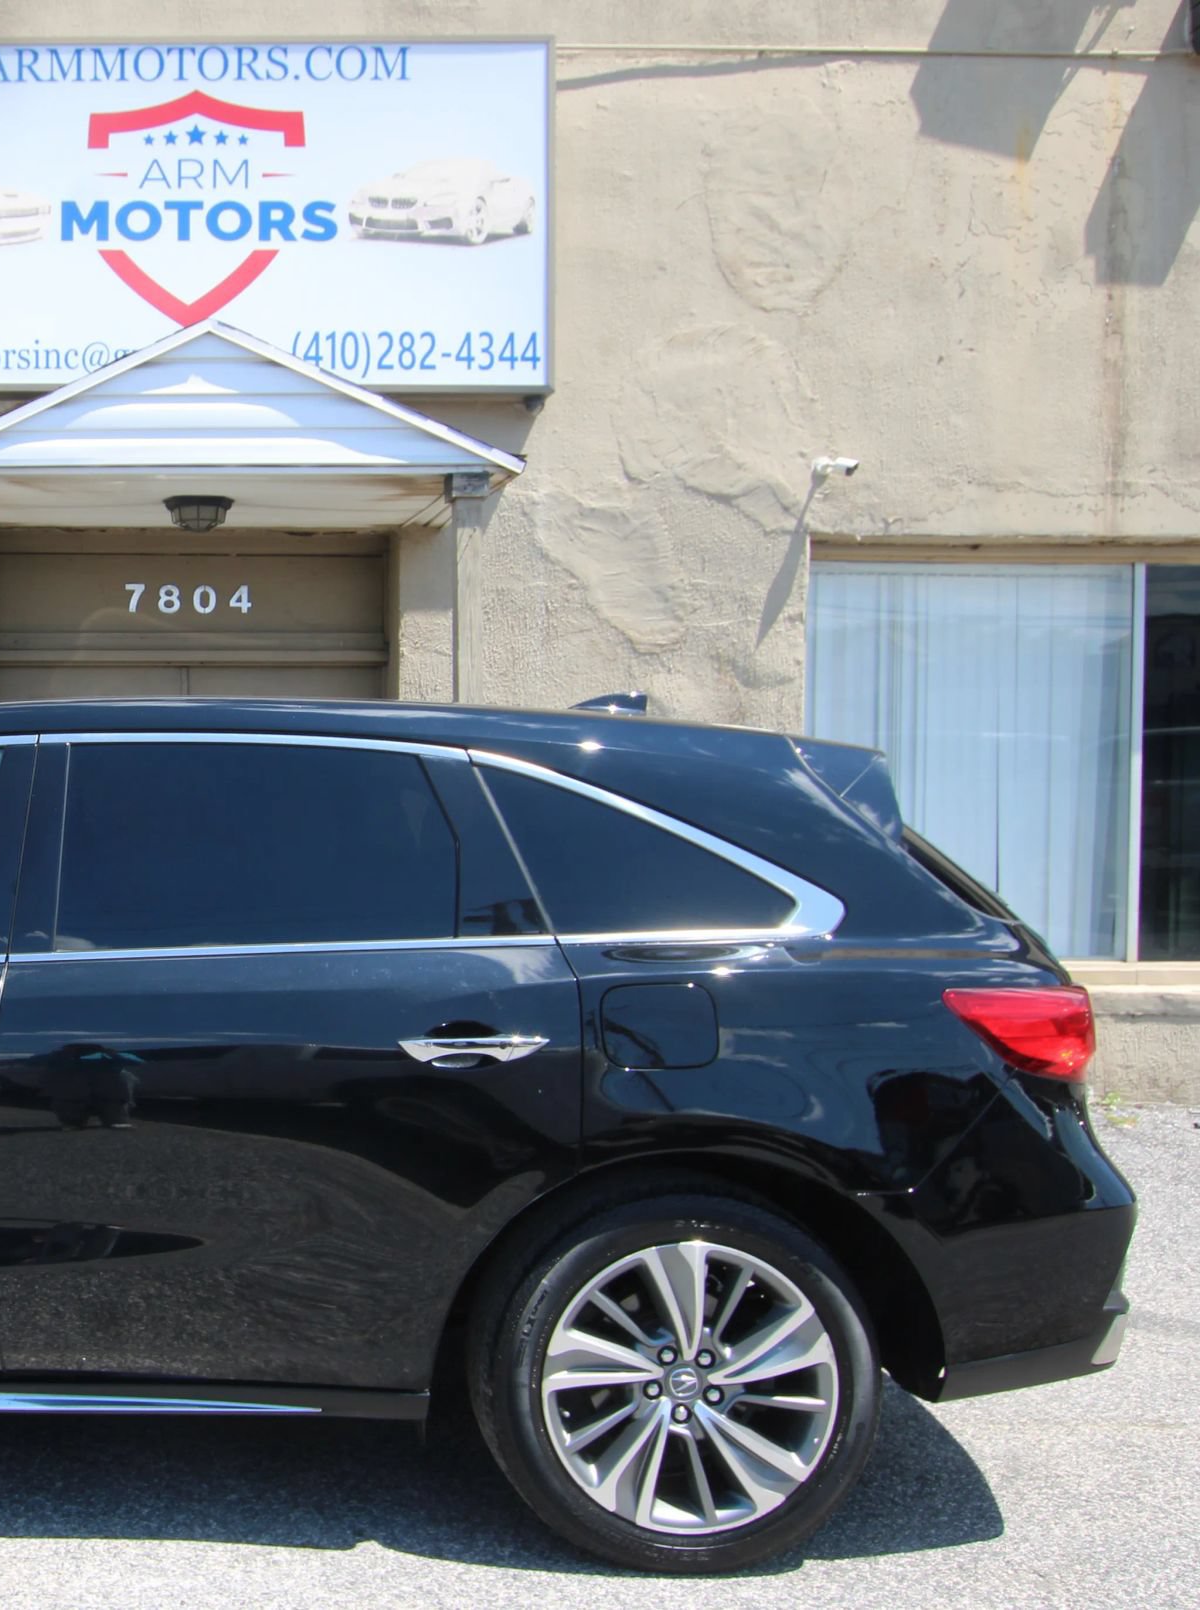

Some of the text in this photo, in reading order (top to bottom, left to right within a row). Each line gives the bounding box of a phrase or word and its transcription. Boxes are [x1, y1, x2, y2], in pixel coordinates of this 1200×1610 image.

[139, 158, 249, 189] ARM
[60, 200, 338, 242] MOTORS
[125, 584, 252, 614] 7804
